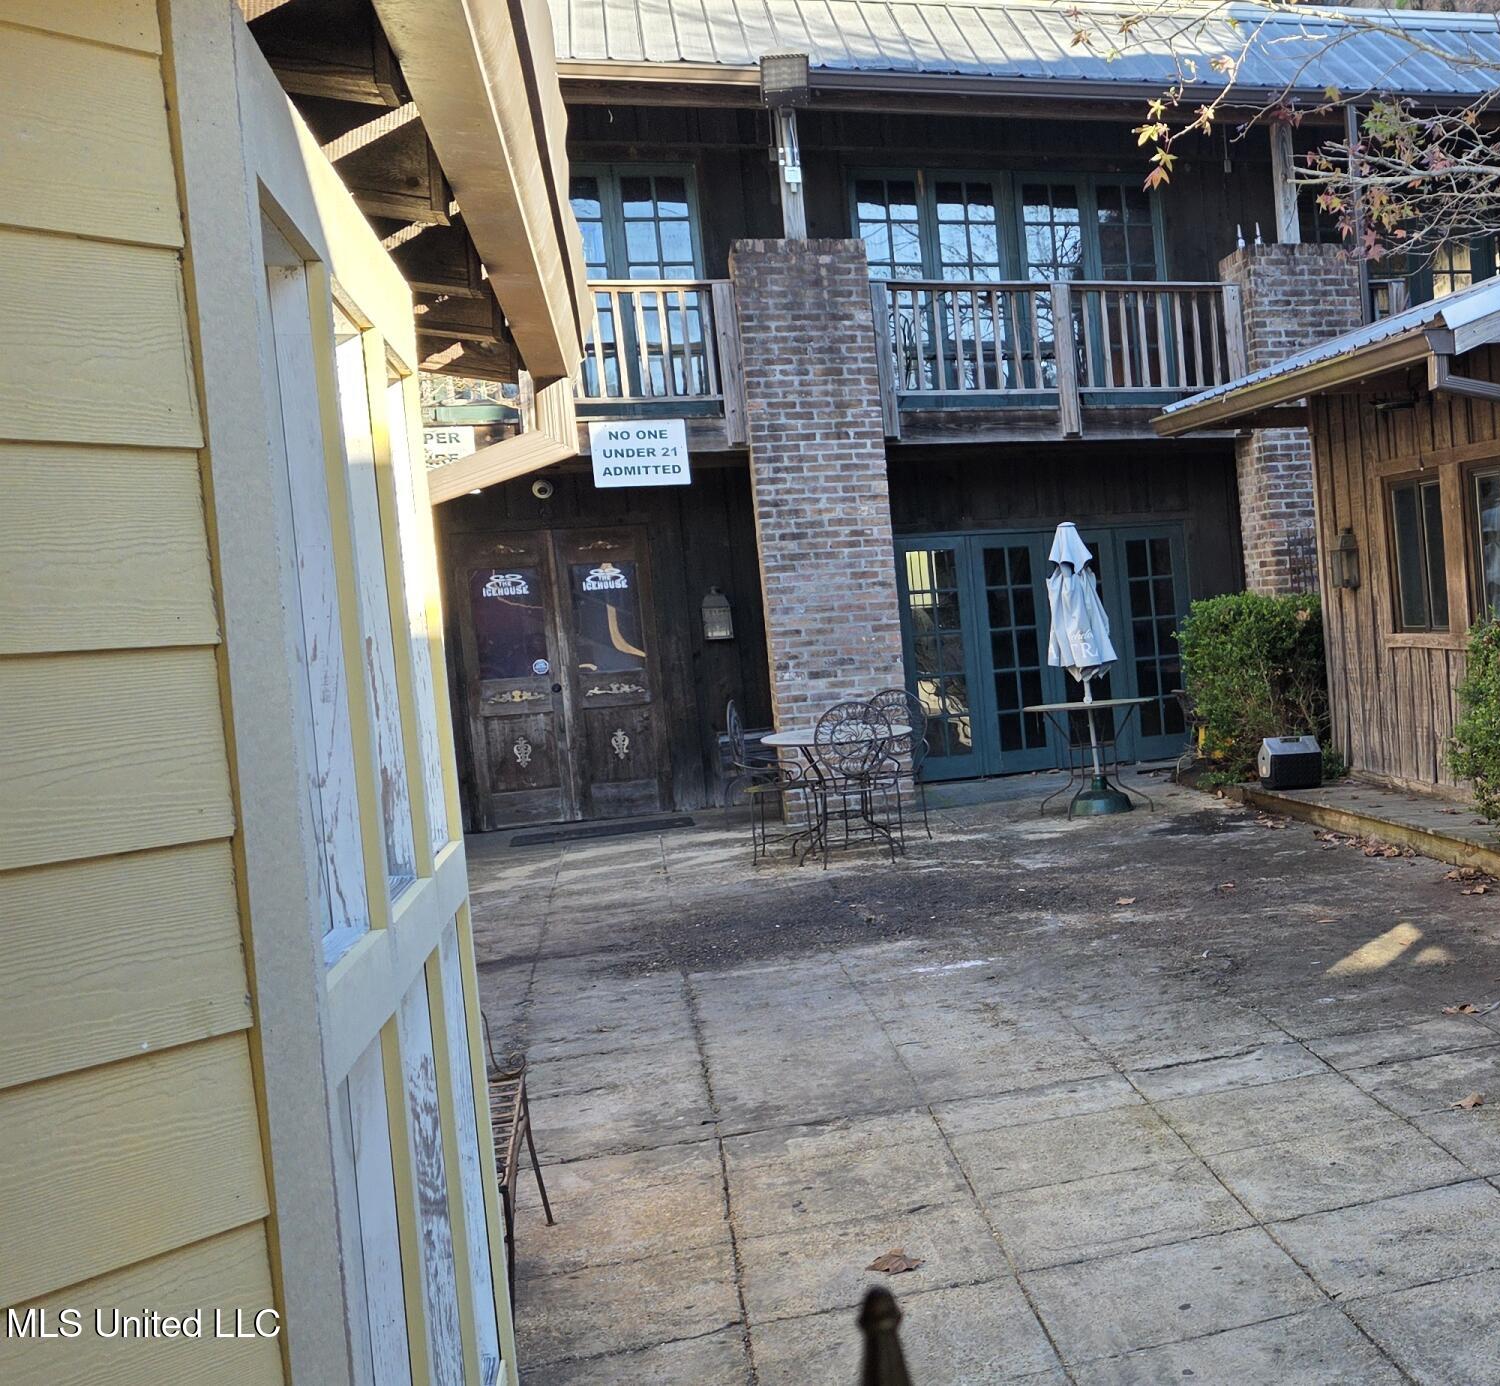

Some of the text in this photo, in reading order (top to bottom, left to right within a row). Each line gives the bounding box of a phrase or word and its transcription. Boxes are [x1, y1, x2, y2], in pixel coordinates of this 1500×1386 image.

[608, 429, 668, 441] NO ONE
[602, 446, 678, 459] UNDER 21
[602, 464, 682, 477] ADMITTED
[482, 585, 529, 597] ICEHOUSE
[582, 579, 628, 591] ICEHOUSE
